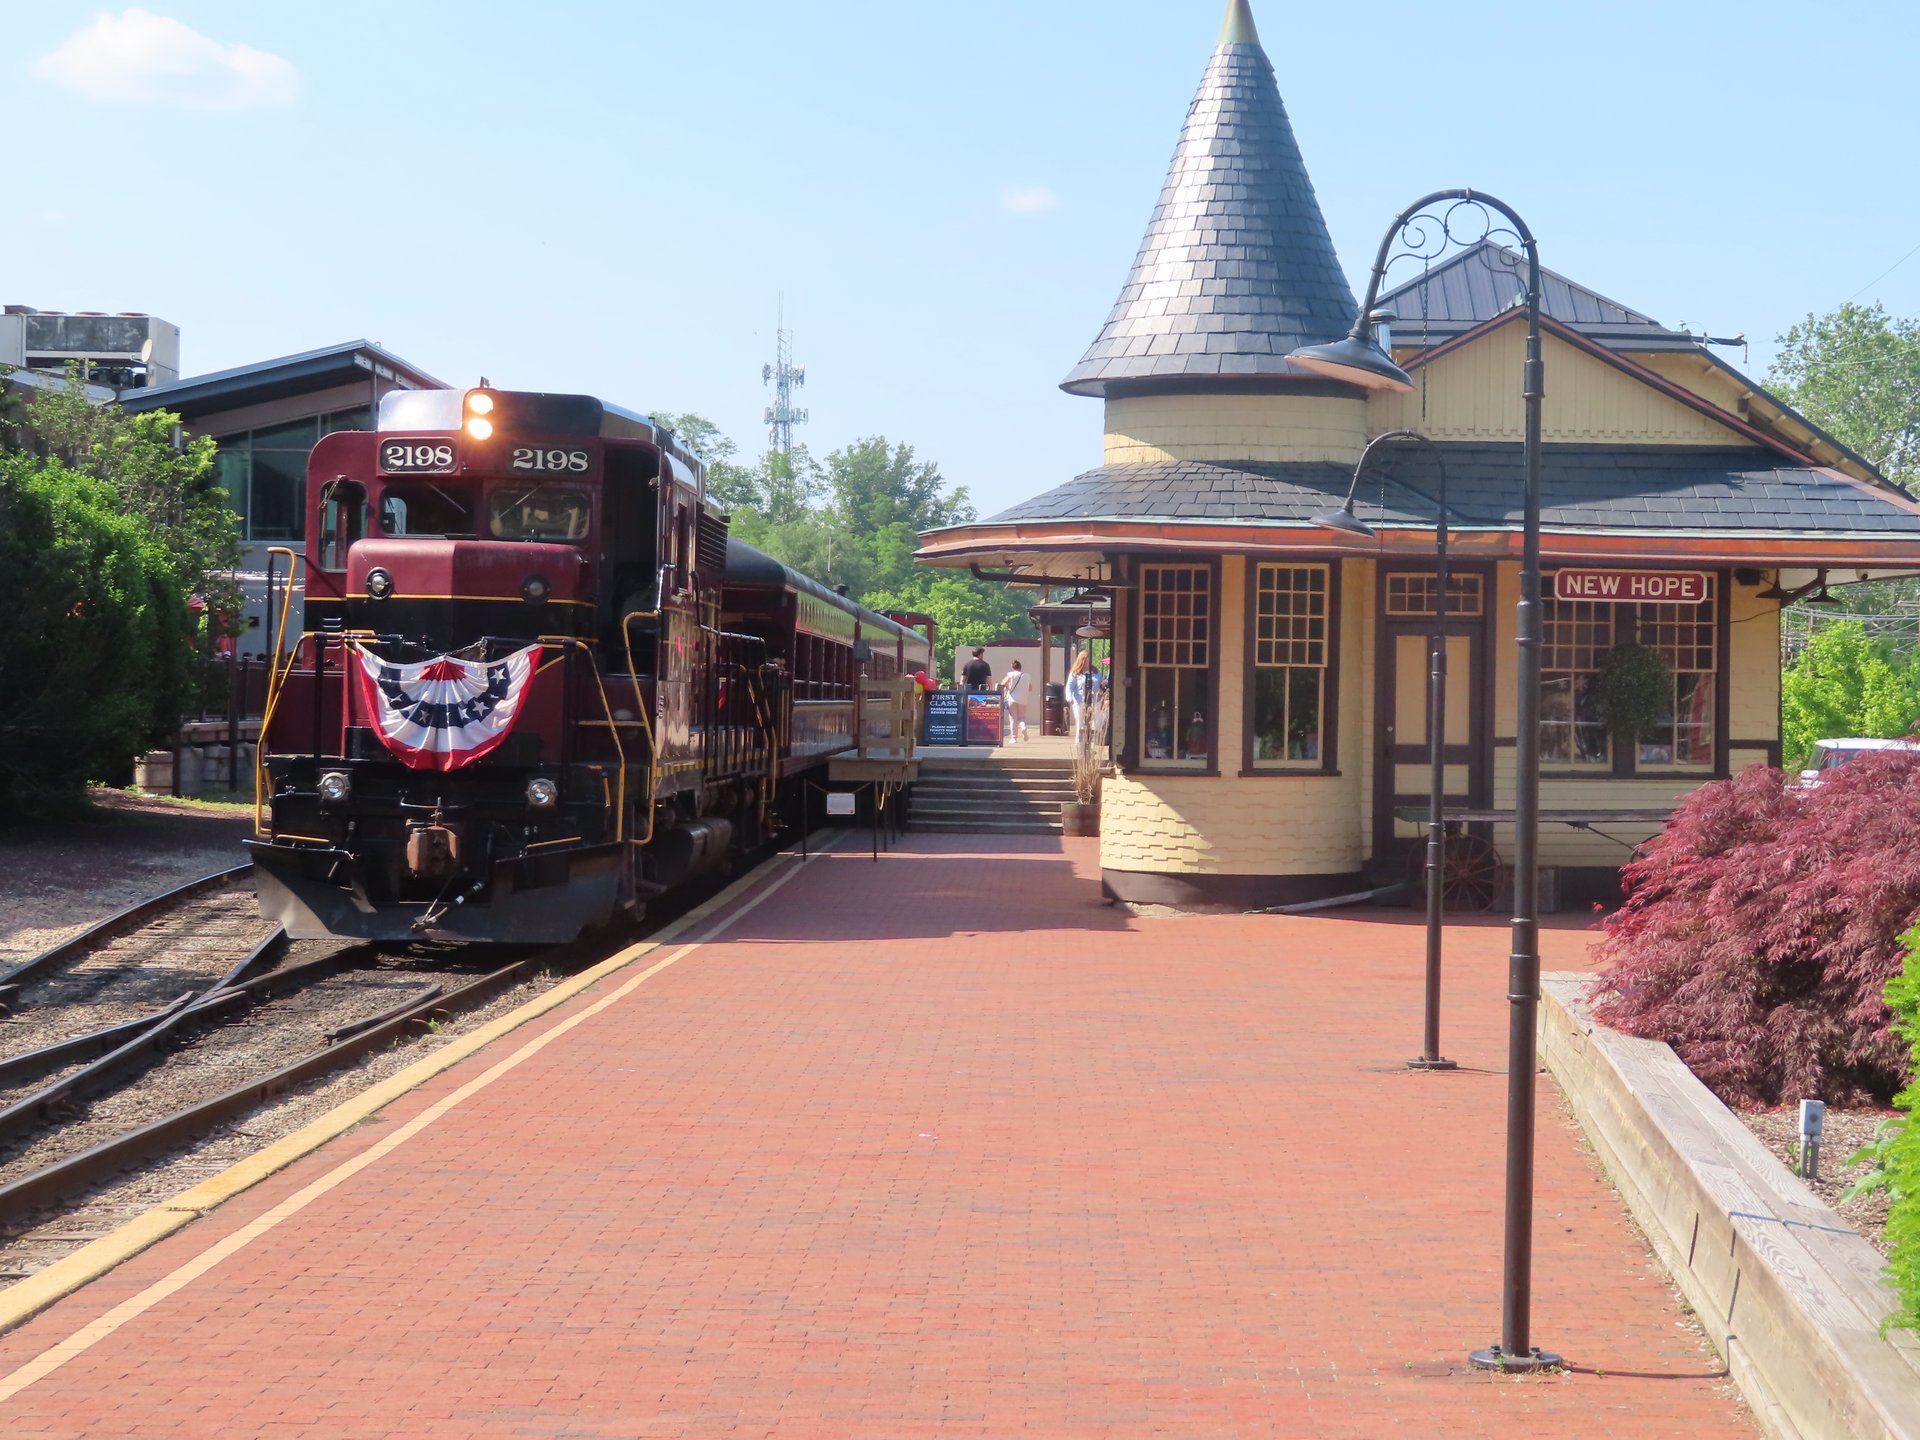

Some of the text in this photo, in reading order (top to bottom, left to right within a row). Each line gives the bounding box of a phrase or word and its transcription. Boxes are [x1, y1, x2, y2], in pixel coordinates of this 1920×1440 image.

[386, 445, 453, 467] 2198
[513, 448, 589, 471] 2198
[1566, 574, 1696, 597] NEW HOPE
